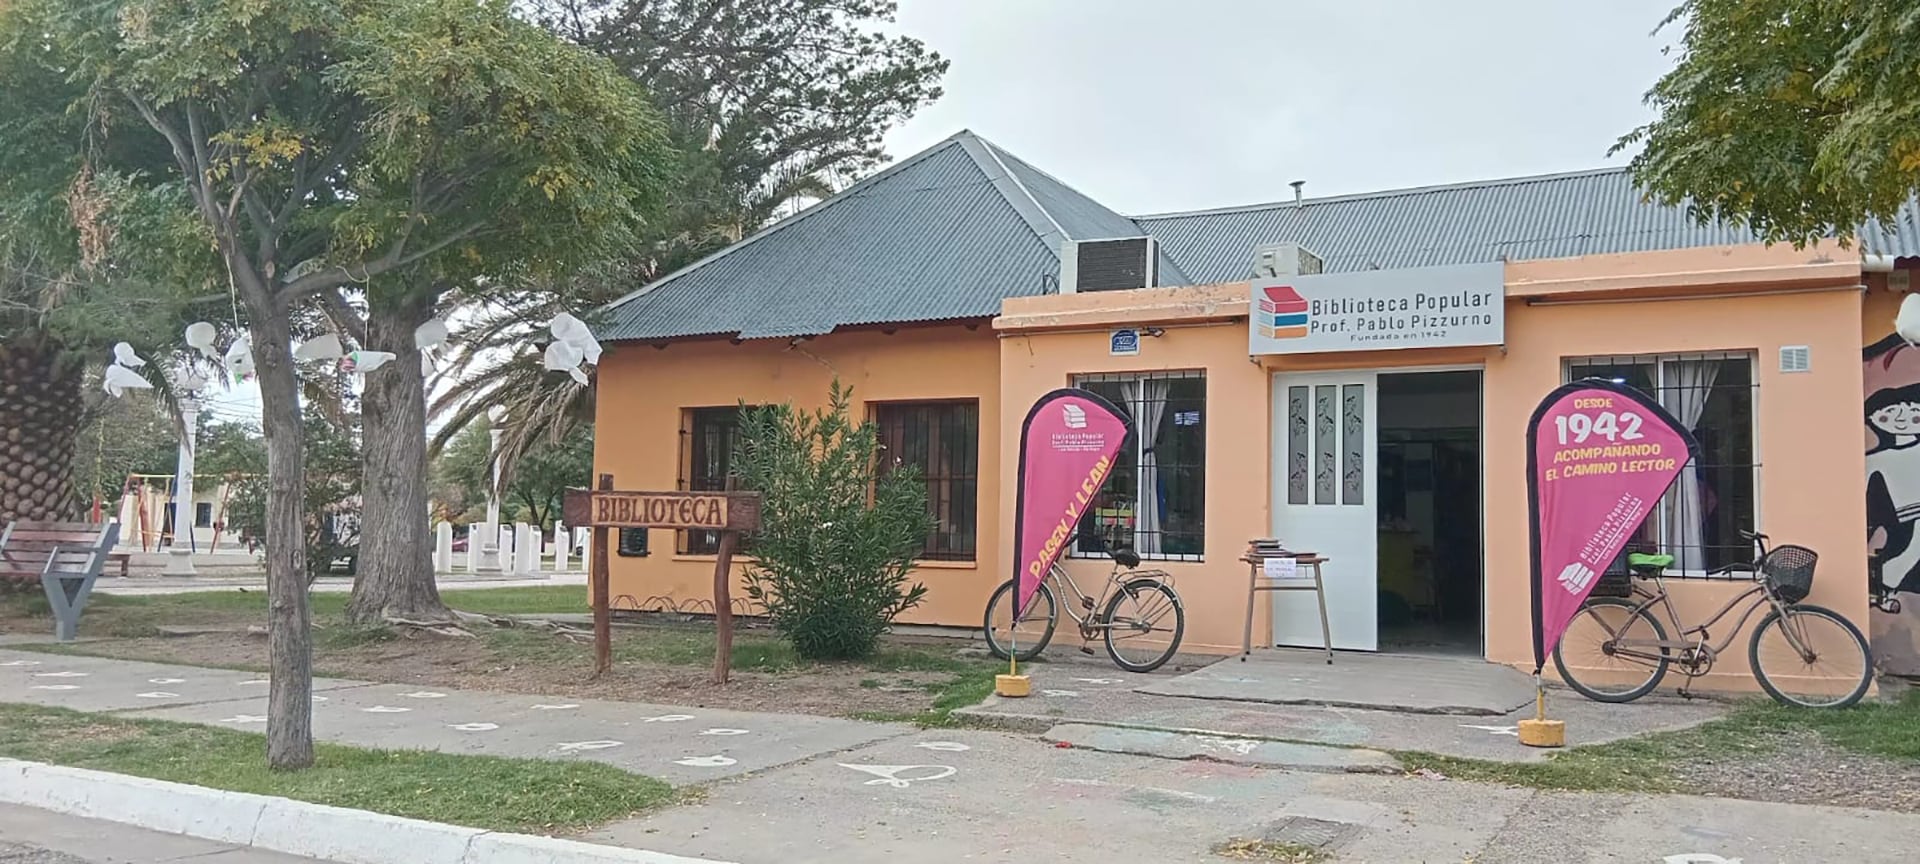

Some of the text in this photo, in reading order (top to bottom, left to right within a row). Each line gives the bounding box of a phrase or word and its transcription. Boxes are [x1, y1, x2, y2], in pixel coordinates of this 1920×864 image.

[1312, 290, 1492, 316] Biblioteca Popular
[1311, 313, 1492, 334] Prof. Pablo Pizzurno
[1350, 334, 1400, 342] Fundada
[1421, 330, 1447, 339] 1942
[1574, 398, 1613, 409] DESDE
[1555, 411, 1644, 445] 1942
[1554, 442, 1661, 464] ACOMPAÑANDO
[1545, 458, 1676, 481] EL CAMINO LECTOR
[598, 498, 722, 525] BIBLIOTECA
[1029, 518, 1070, 578] PASEN
[1065, 502, 1079, 519] Y
[1075, 455, 1111, 501] LEAN
